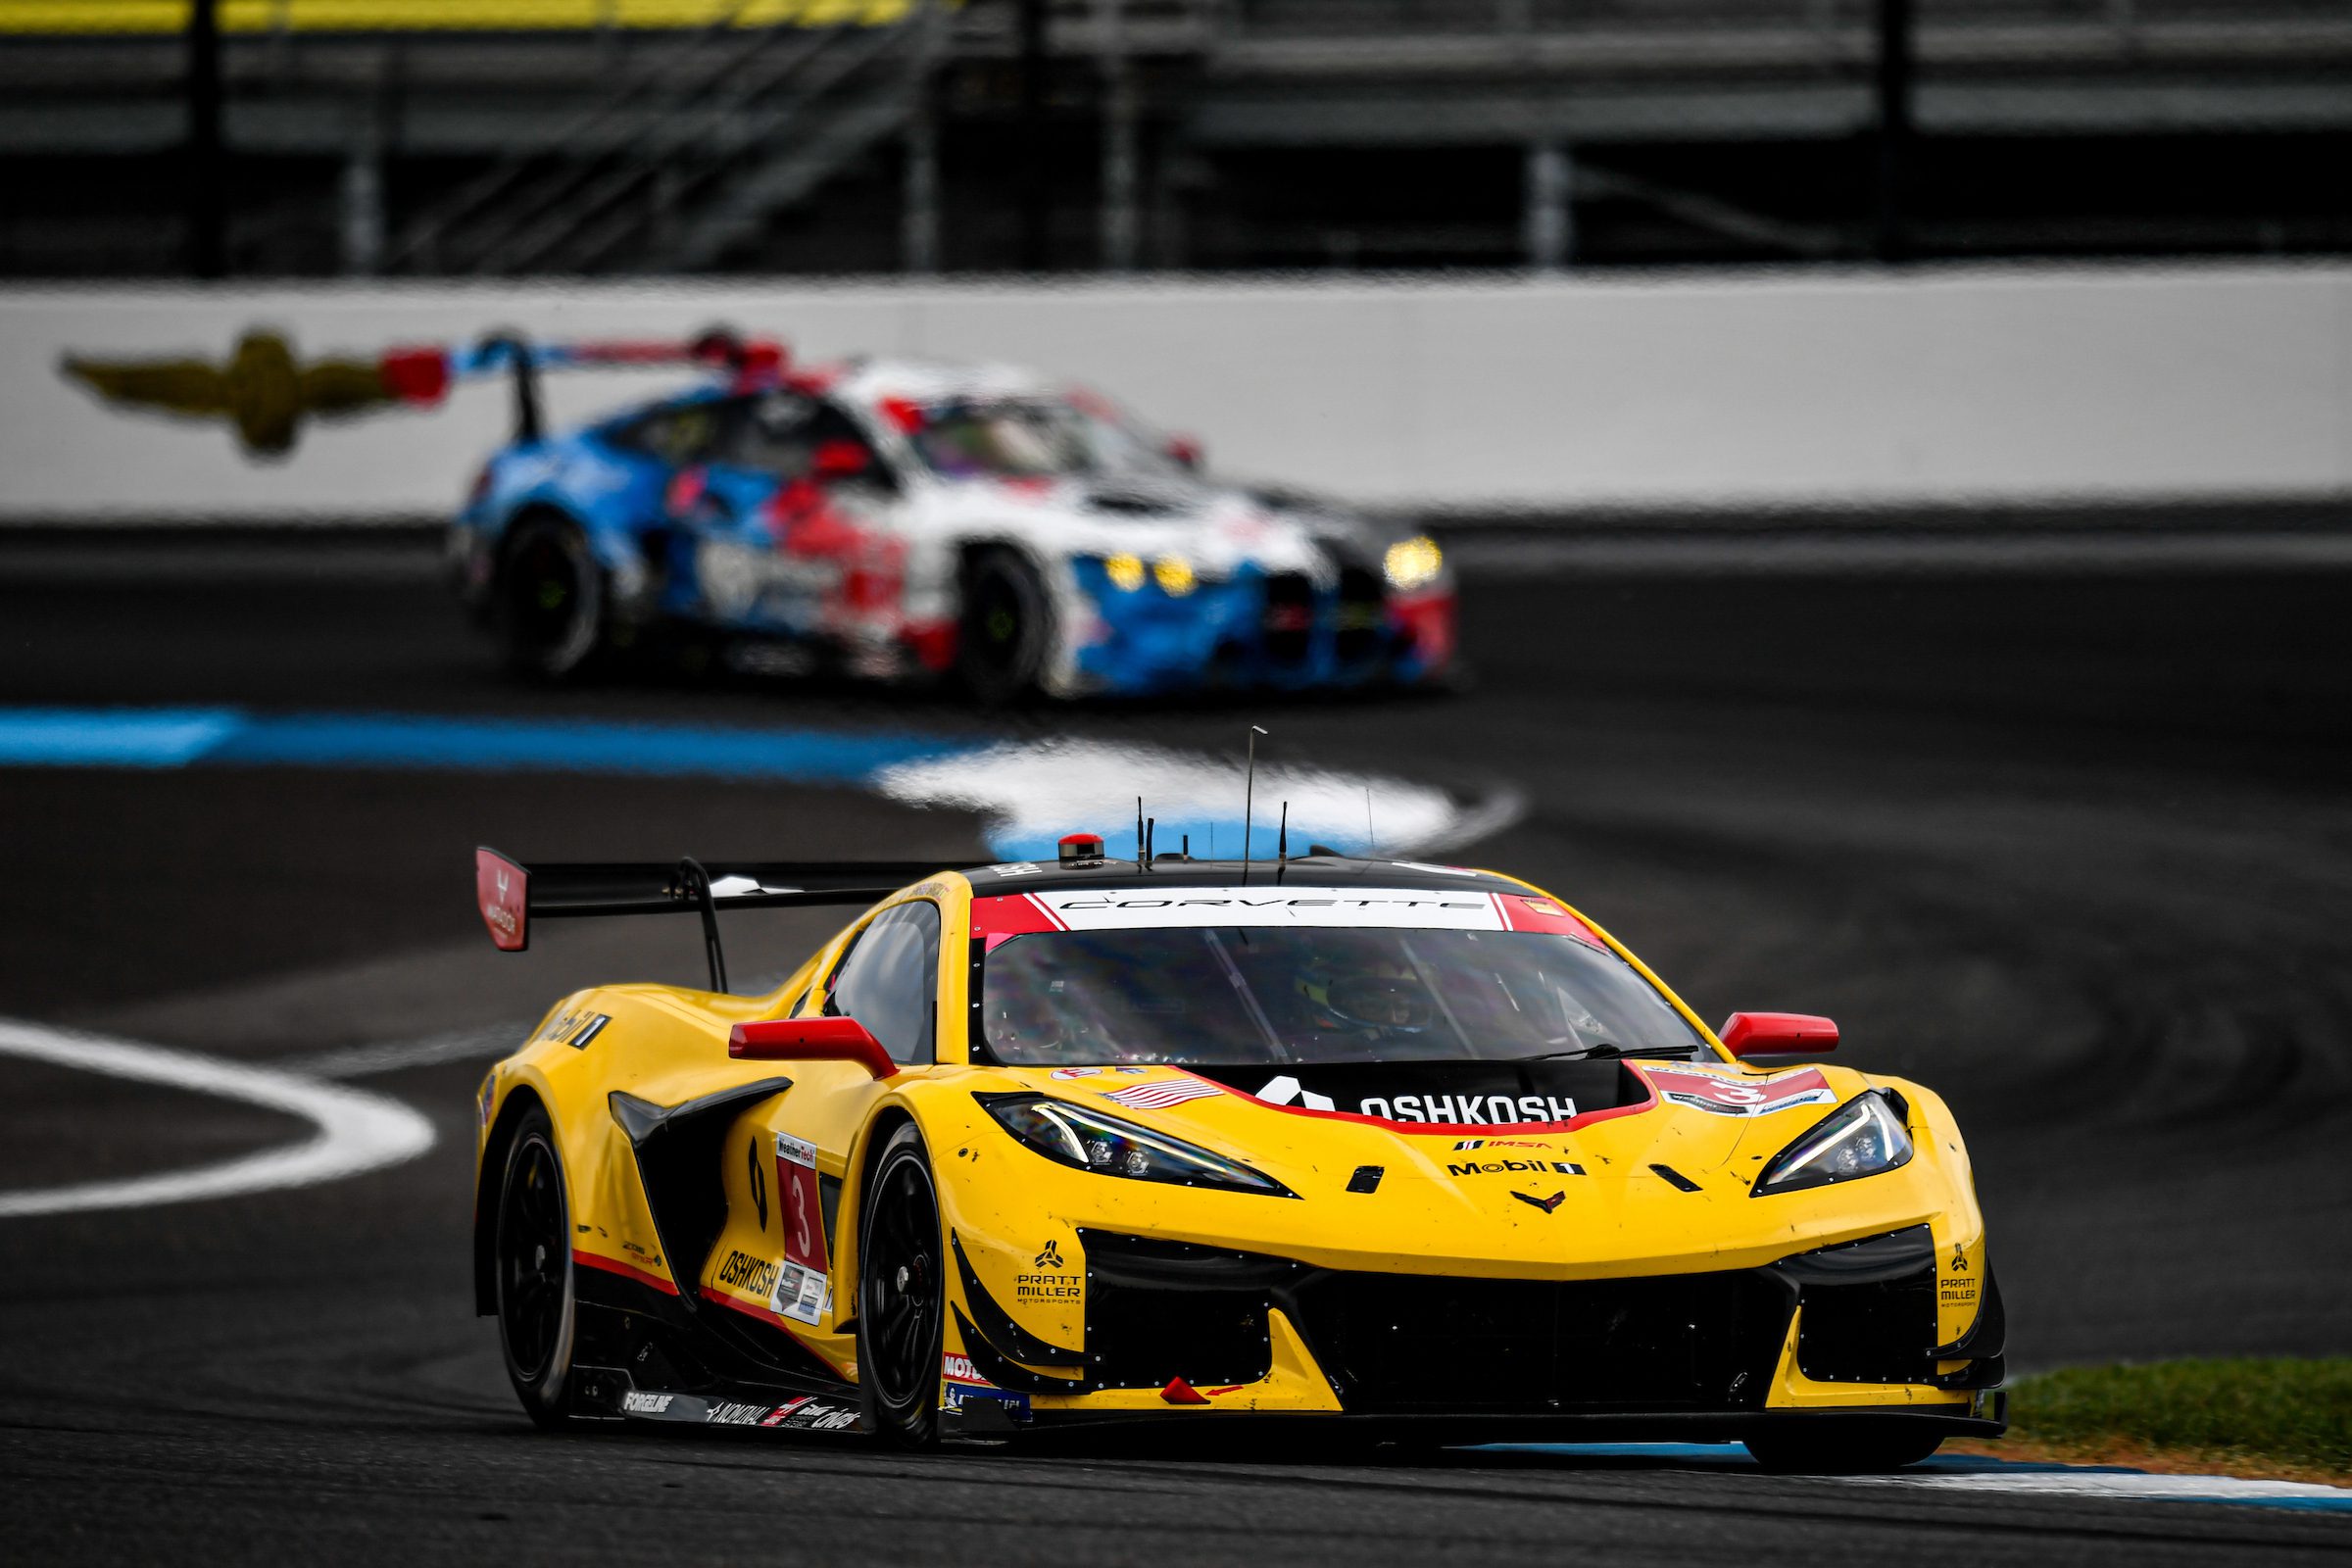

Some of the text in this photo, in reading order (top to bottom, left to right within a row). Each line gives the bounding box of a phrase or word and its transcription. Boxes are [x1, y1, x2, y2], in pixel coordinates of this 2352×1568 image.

[1058, 899, 1487, 909] CORVETTE
[1709, 1081, 1767, 1104] 3
[1360, 1094, 1579, 1125] OSHKOSH
[1489, 1141, 1552, 1150] IMSA
[1446, 1159, 1547, 1176] Mobil
[792, 1175, 810, 1258] 3
[719, 1250, 780, 1298] OSHKOSH
[1018, 1275, 1082, 1285] PRATT
[1940, 1278, 1976, 1288] PRATT
[1017, 1287, 1081, 1297] MILLER
[1940, 1290, 1976, 1300] MILLER
[944, 1355, 987, 1381] MOTU
[623, 1392, 674, 1412] FORGELINE
